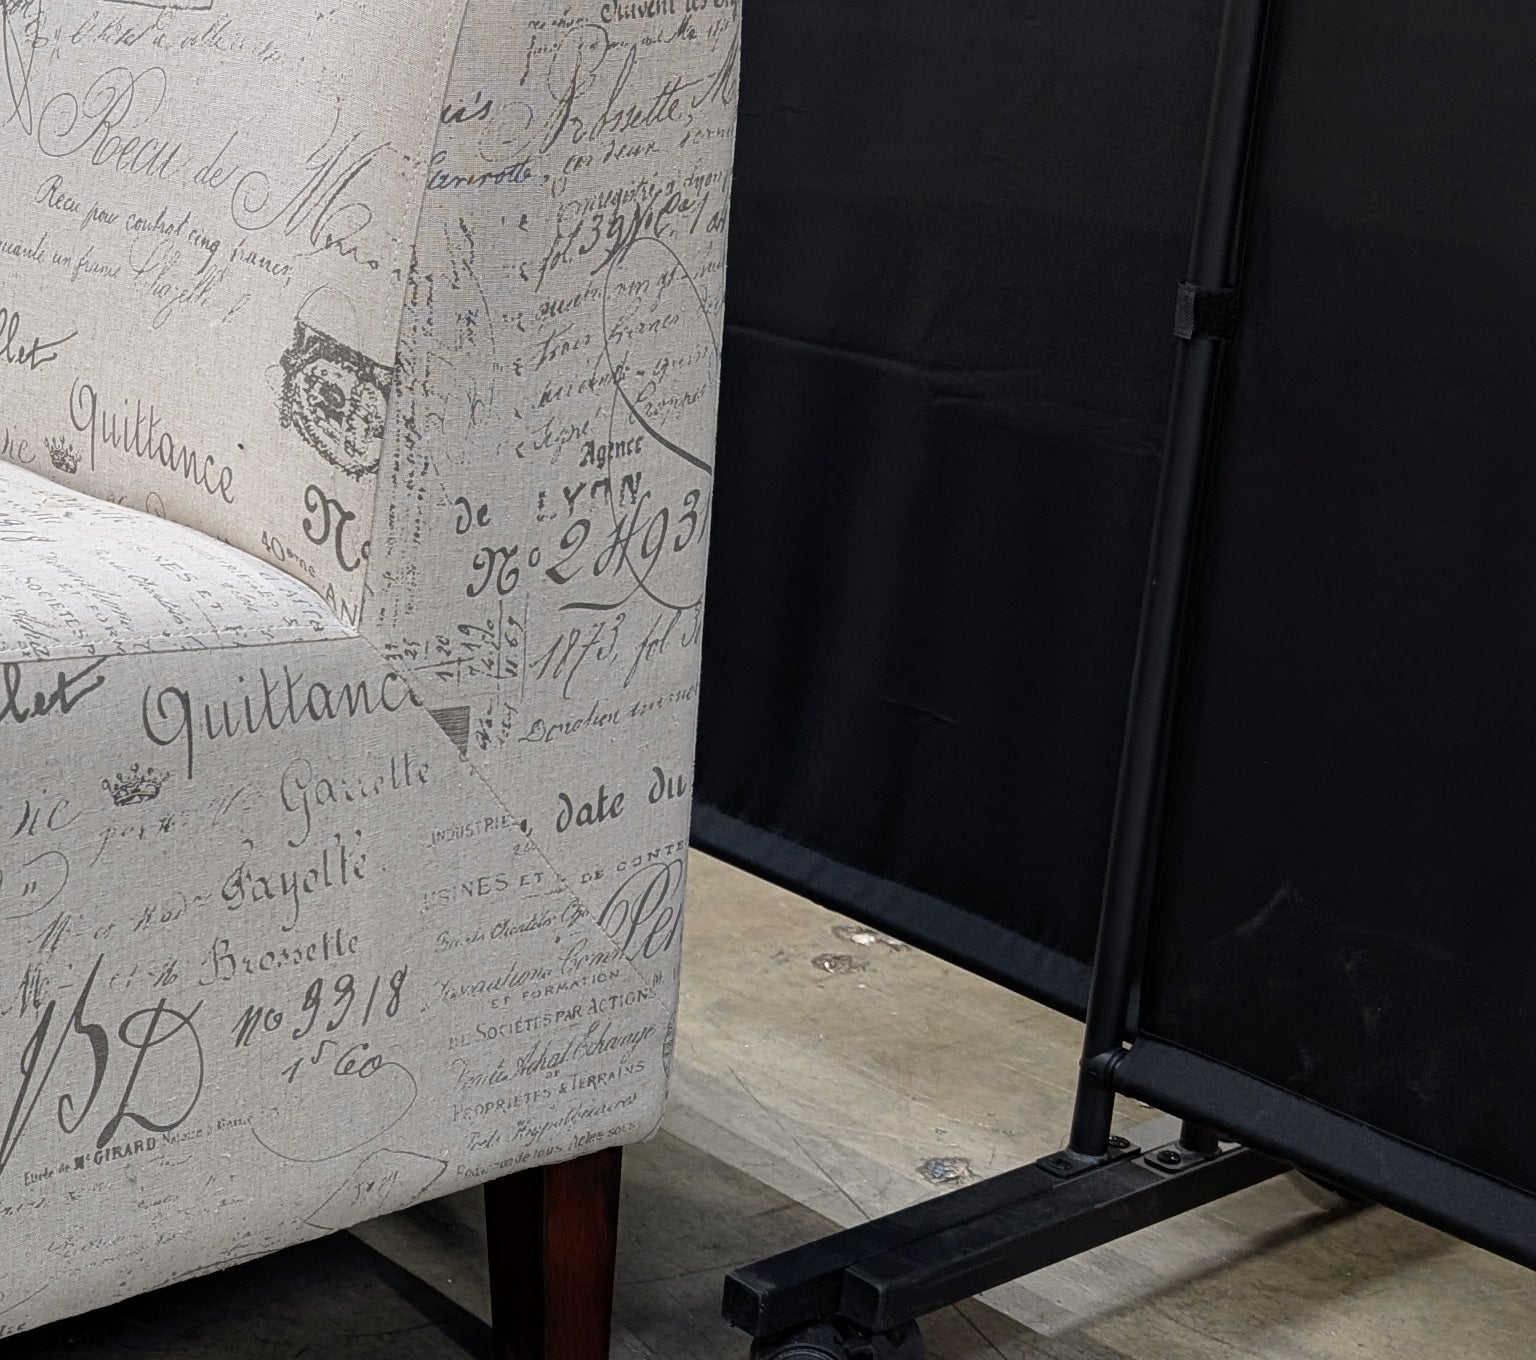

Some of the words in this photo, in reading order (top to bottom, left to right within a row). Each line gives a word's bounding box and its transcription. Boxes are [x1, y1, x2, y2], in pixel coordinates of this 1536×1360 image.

[69, 376, 236, 505] Quittance
[455, 495, 492, 535] de
[556, 774, 625, 835] date
[647, 764, 687, 804] du
[555, 1006, 583, 1025] PAR
[93, 1136, 158, 1167] GIRARD
